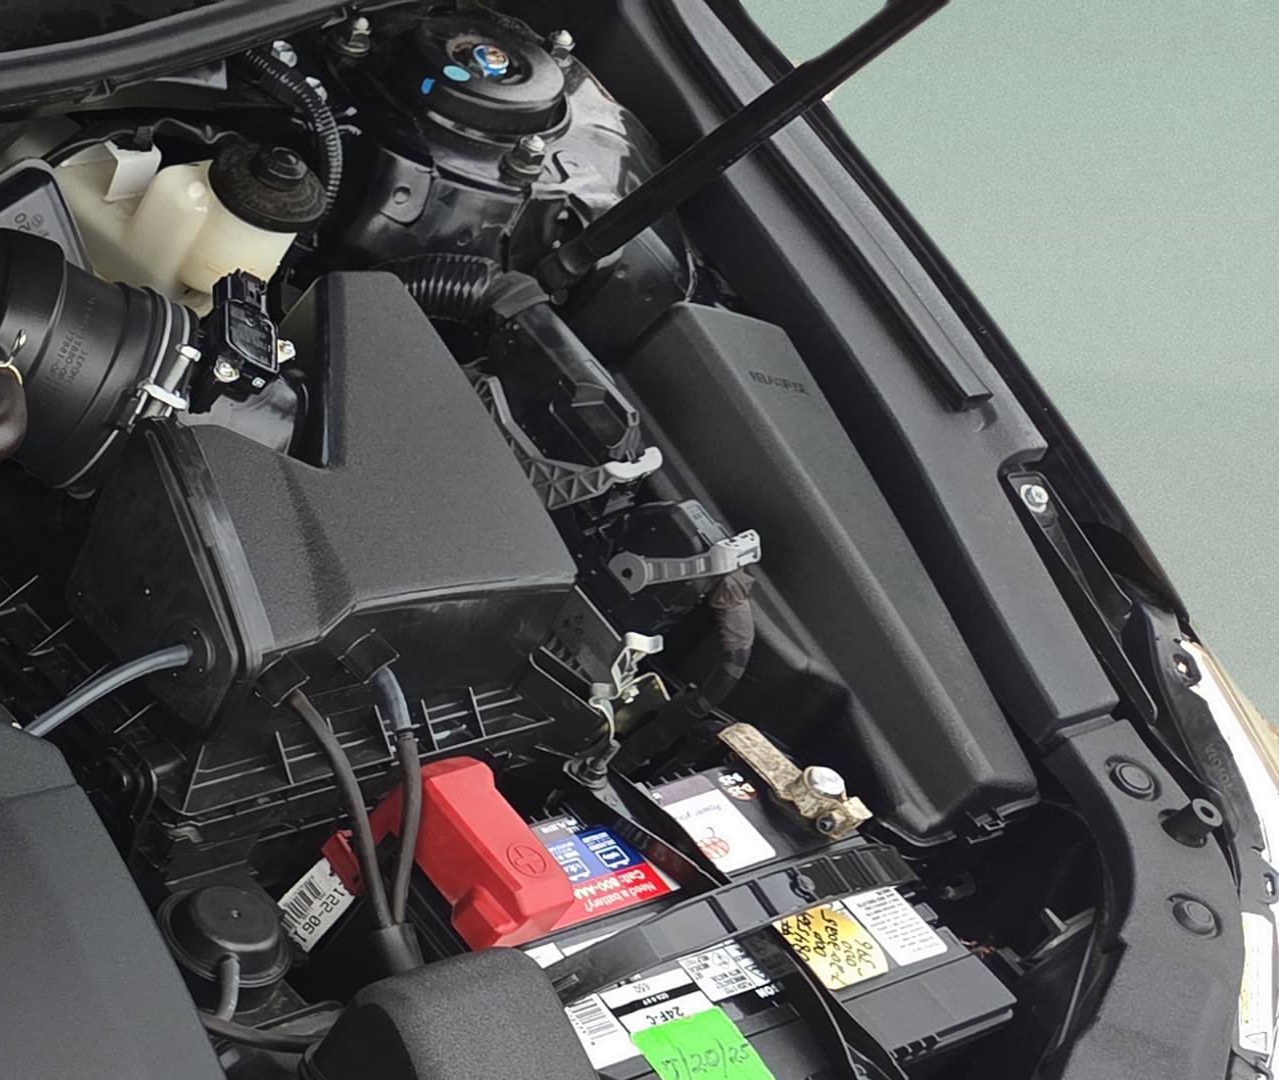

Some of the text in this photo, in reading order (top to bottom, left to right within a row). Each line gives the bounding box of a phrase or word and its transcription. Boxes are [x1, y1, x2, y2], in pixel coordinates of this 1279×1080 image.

[584, 881, 657, 912] Need a battery?
[646, 1006, 684, 1026] 24F-C
